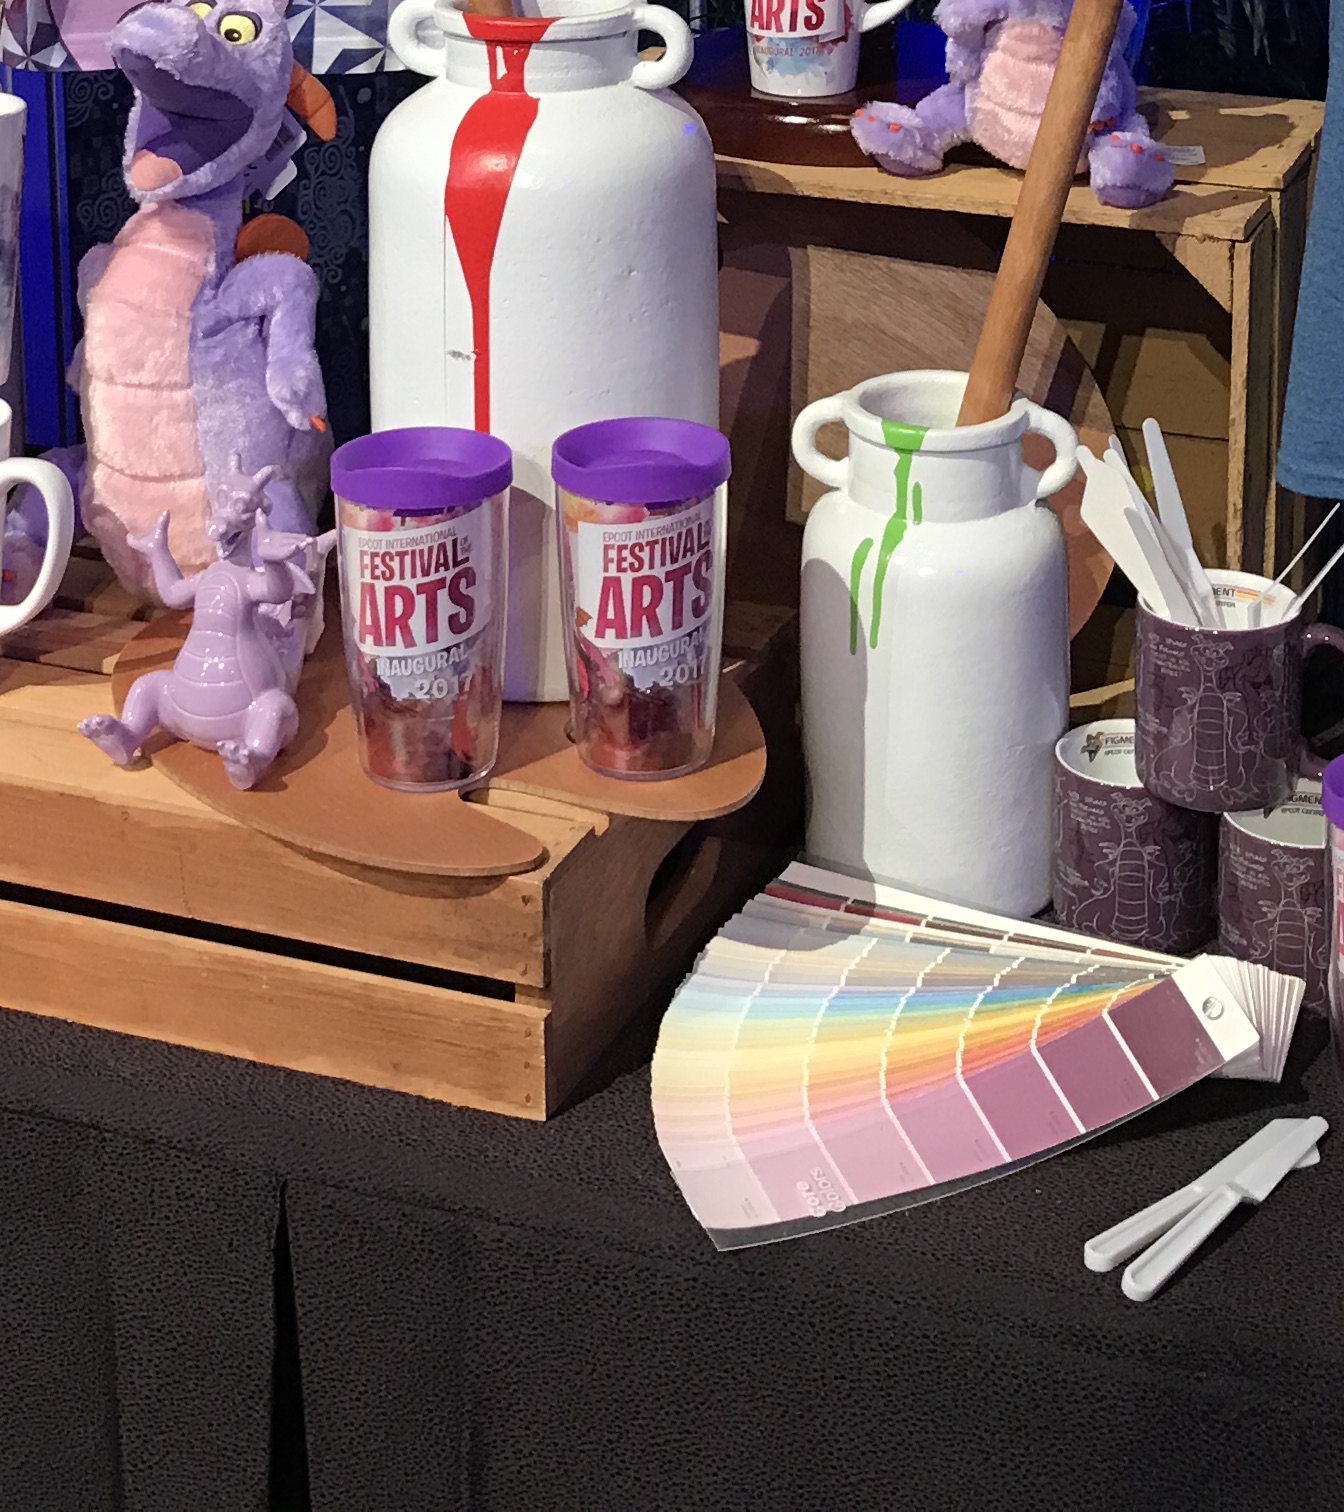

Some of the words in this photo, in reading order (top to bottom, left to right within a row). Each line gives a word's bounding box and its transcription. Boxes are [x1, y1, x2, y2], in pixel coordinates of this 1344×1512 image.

[358, 536, 383, 549] EPCOT
[385, 527, 456, 550] INTERNATIONAL
[603, 531, 633, 544] EPCOT
[635, 511, 702, 541] INTERNATIONAL
[359, 538, 470, 581] FESTIVAL
[602, 521, 710, 573] FESTIVAL
[359, 566, 477, 649] ARTS
[594, 549, 714, 639] ARTS
[376, 644, 468, 677] INAUGURAL
[618, 631, 705, 670] INAUGURAL
[415, 671, 473, 699] 2017
[659, 657, 707, 688] 2017
[796, 1181, 827, 1218] Core
[810, 1167, 846, 1212] Colors
